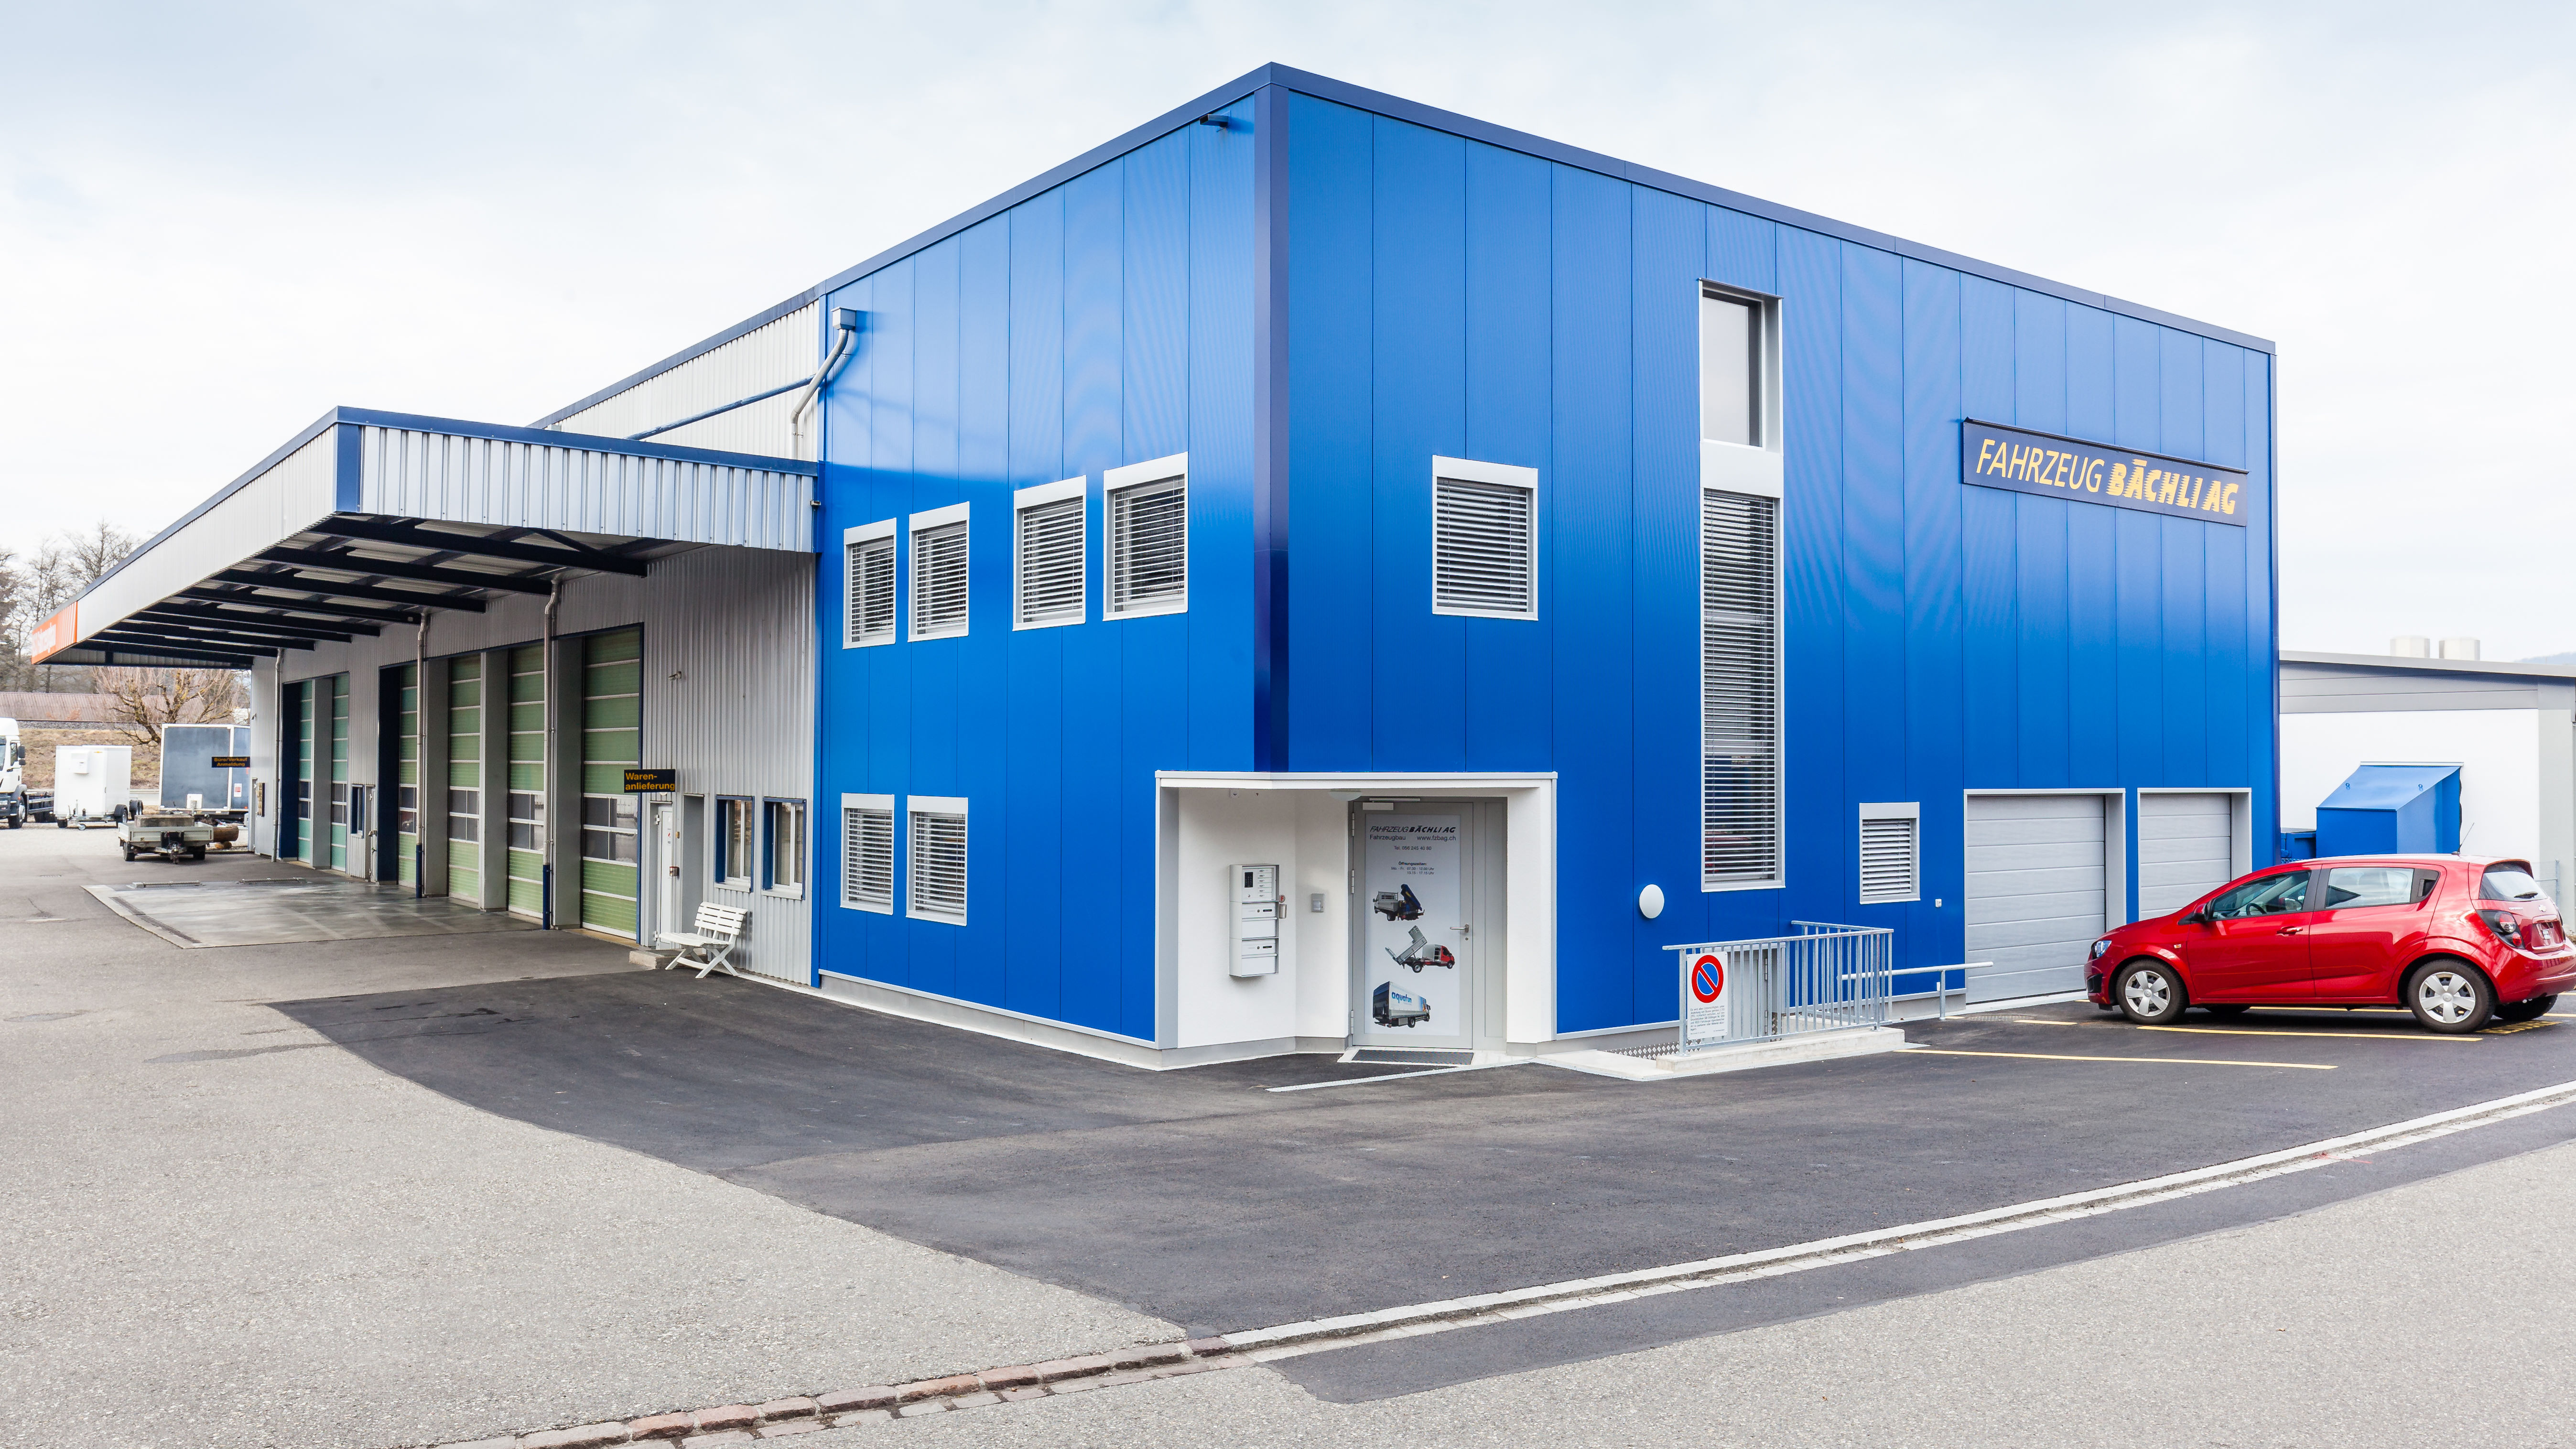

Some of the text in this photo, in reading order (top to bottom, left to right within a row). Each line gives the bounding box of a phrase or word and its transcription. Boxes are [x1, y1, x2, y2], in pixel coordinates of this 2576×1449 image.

[1976, 438, 2105, 493] FAHRZEUG
[2200, 480, 2239, 515] AG
[626, 772, 658, 780] Waren-
[625, 782, 675, 791] anlieferung
